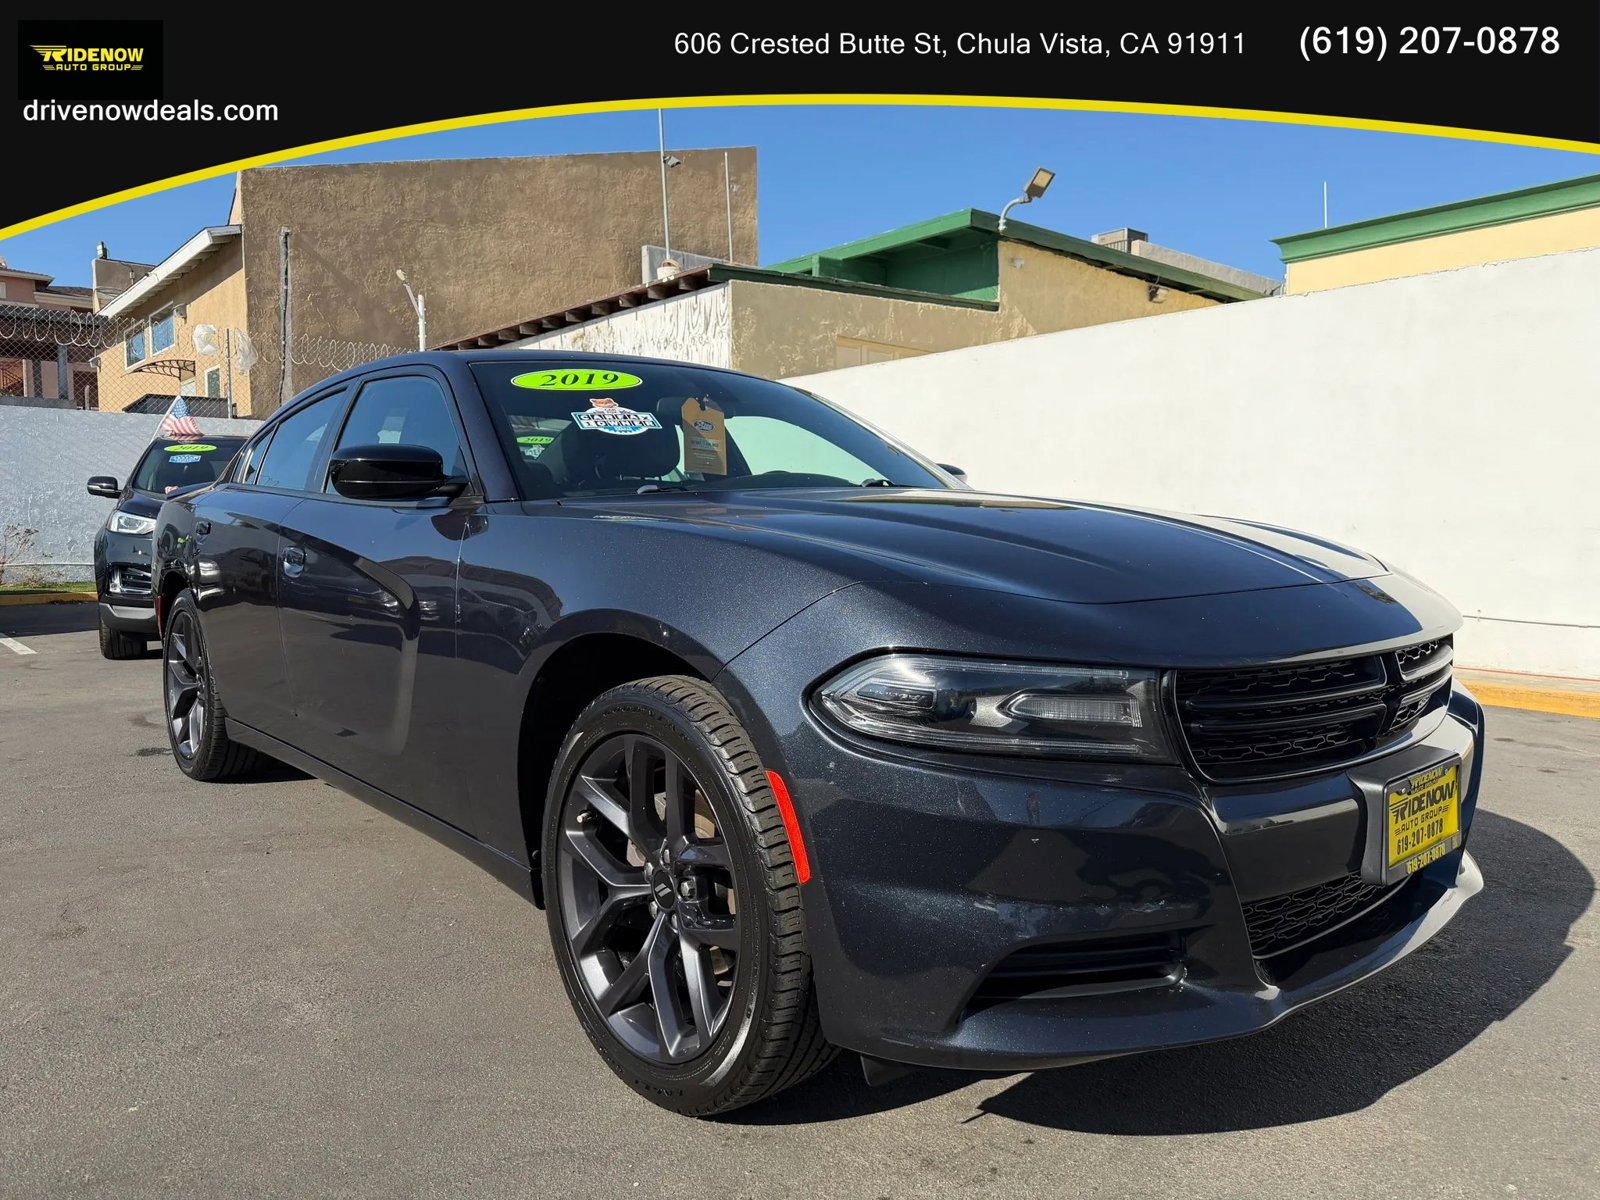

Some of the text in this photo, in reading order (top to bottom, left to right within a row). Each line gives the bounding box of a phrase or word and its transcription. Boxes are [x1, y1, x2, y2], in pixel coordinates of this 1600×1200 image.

[540, 373, 619, 387] 2019
[580, 413, 651, 421] CARFAX
[1390, 780, 1455, 825] RIDENOW
[1401, 806, 1442, 832] AUTO GROUP
[1397, 818, 1444, 856] 619-207-0878
